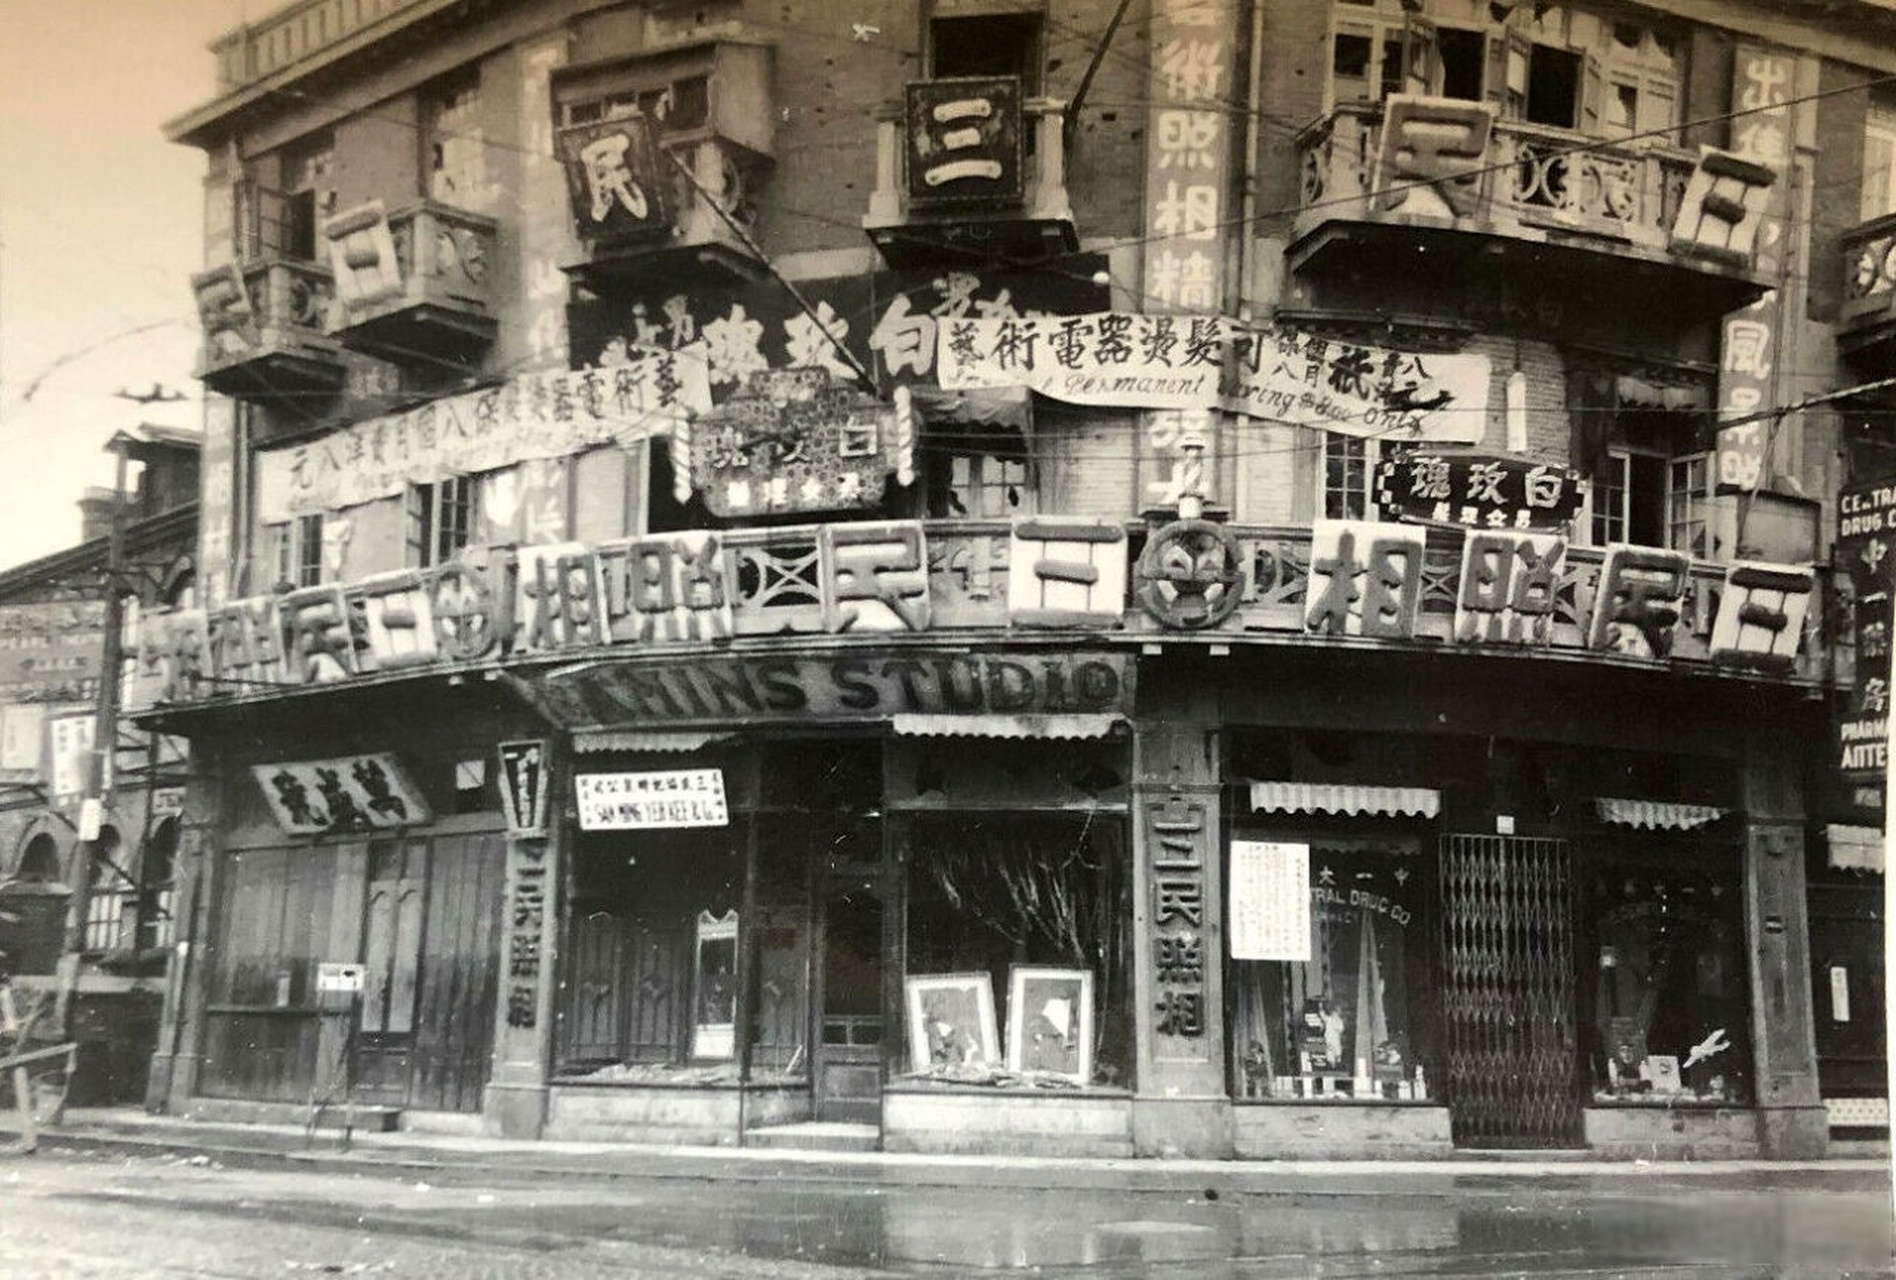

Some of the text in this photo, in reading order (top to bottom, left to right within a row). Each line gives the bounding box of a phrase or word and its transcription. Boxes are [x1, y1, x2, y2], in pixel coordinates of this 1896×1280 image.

[924, 98, 1004, 185] 三
[1410, 457, 1563, 508] 白玫瑰
[1841, 513, 1882, 536] DRUG
[829, 653, 1122, 714] STUDIO
[1156, 822, 1203, 1037] 三民照相
